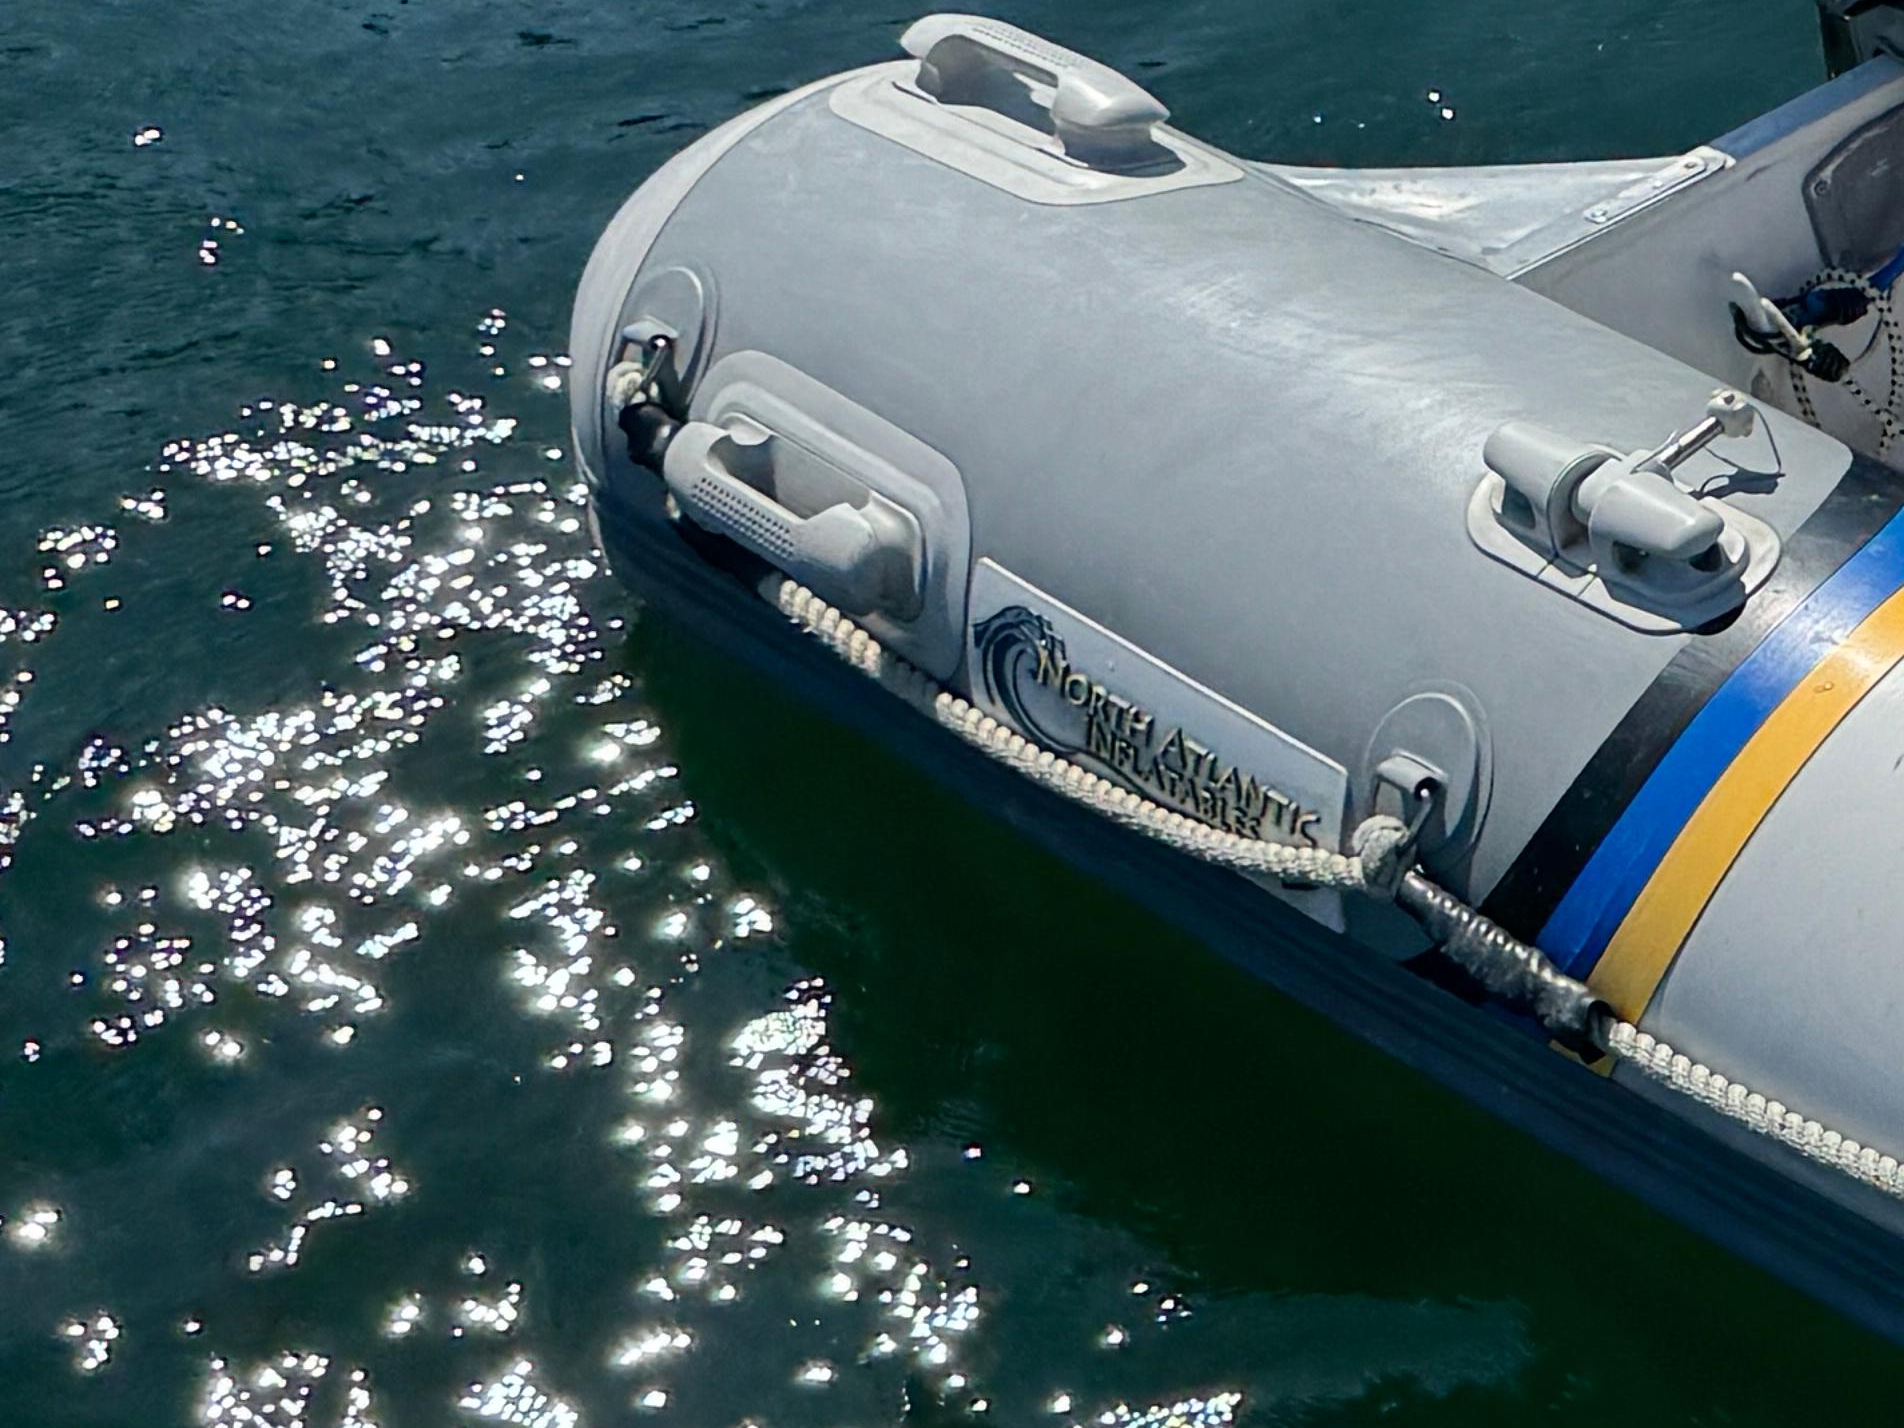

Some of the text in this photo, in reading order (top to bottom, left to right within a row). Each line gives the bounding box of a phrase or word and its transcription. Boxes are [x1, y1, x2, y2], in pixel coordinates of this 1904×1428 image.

[1033, 638, 1323, 848] NORTH ATLANTIC
[1086, 712, 1264, 843] INFLATABLES
